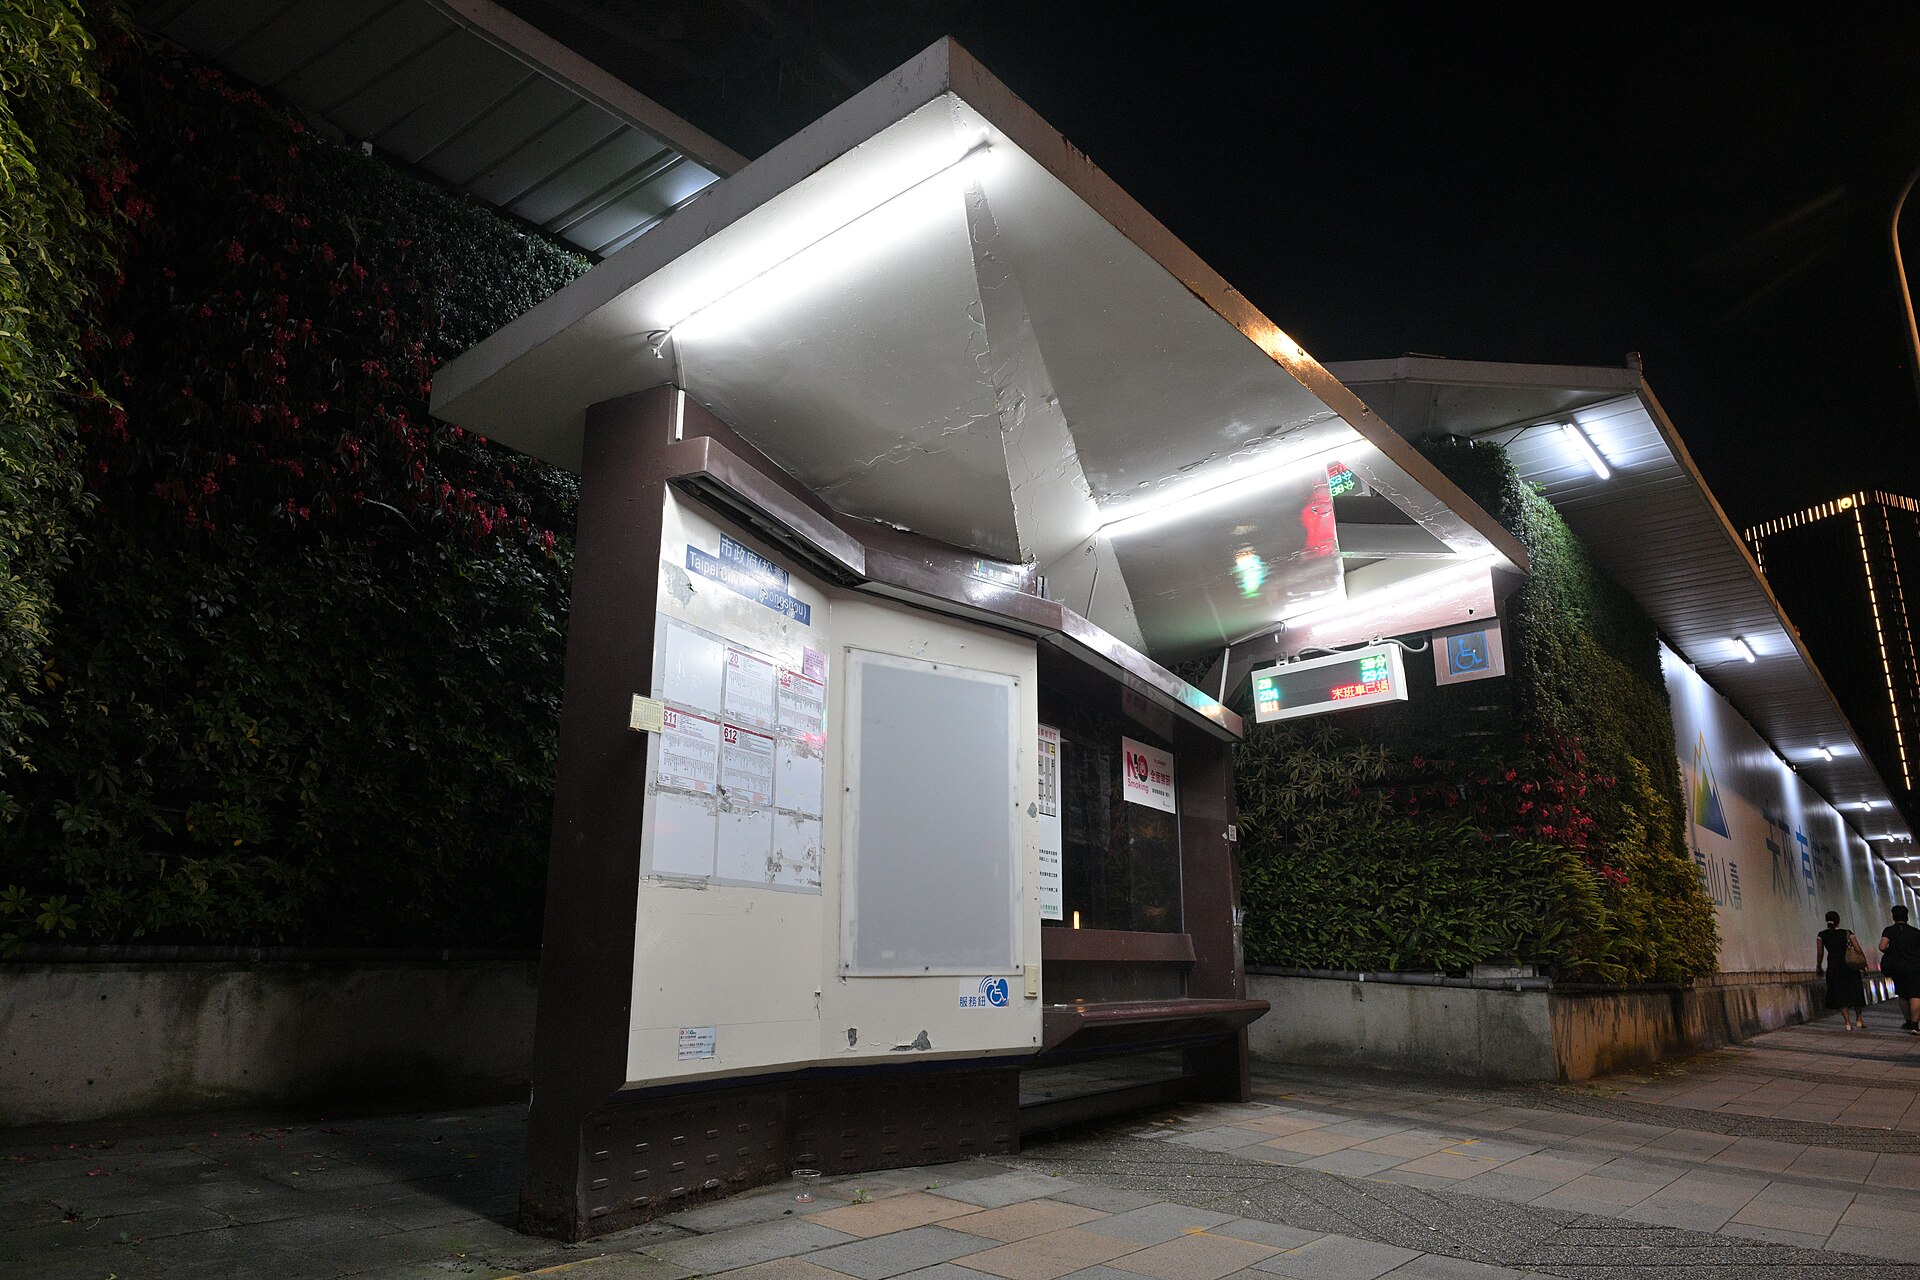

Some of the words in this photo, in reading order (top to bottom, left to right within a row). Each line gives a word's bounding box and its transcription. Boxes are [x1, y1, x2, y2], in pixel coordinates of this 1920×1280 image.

[689, 551, 719, 578] Taipei
[663, 710, 677, 725] 611
[723, 727, 738, 741] 612
[1127, 777, 1149, 794] Smoking
[959, 996, 986, 1008] 服務鈕
